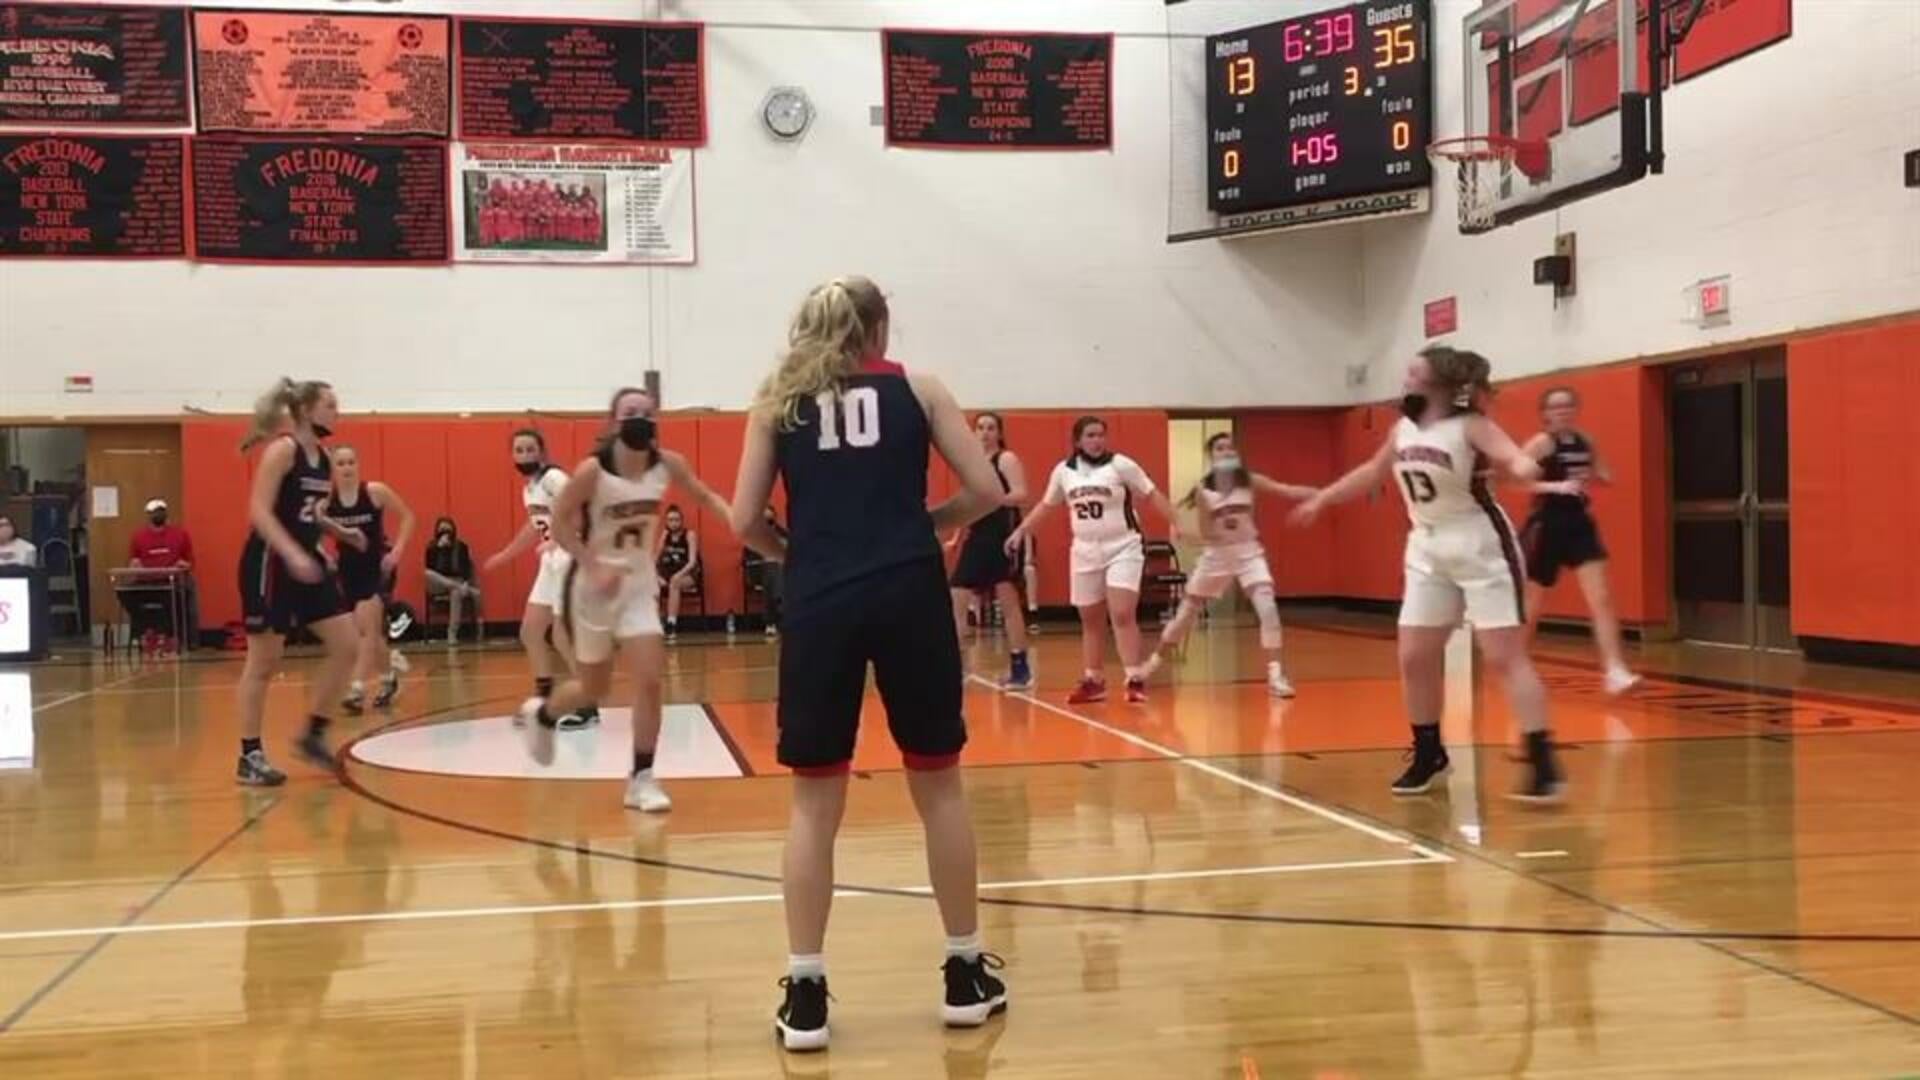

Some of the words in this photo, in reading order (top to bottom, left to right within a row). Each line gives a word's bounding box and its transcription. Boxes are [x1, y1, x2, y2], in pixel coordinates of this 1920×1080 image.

[1284, 13, 1353, 62] 6:39
[1373, 24, 1415, 68] 35
[1215, 39, 1249, 58] Home
[970, 71, 1029, 84] BASEBALL
[1229, 57, 1255, 95] 13
[982, 101, 1018, 113] STATE
[969, 116, 1032, 129] CHAMPIONS
[1393, 121, 1409, 151] 0
[2, 139, 106, 175] FREDONIA
[1224, 150, 1239, 178] 0
[260, 147, 379, 188] FREDONIA
[21, 177, 87, 192] BASEBALL
[289, 186, 354, 199] BASEBALL
[21, 194, 48, 208] NEW
[56, 194, 87, 208] YORK
[289, 201, 317, 213] NEW
[321, 201, 355, 214] YORK
[36, 211, 72, 225] STATE
[304, 215, 342, 228] STATE
[20, 228, 91, 241] CHAMPIONS
[816, 387, 880, 450] 10
[1401, 470, 1437, 503] 13
[1074, 501, 1104, 520] 20
